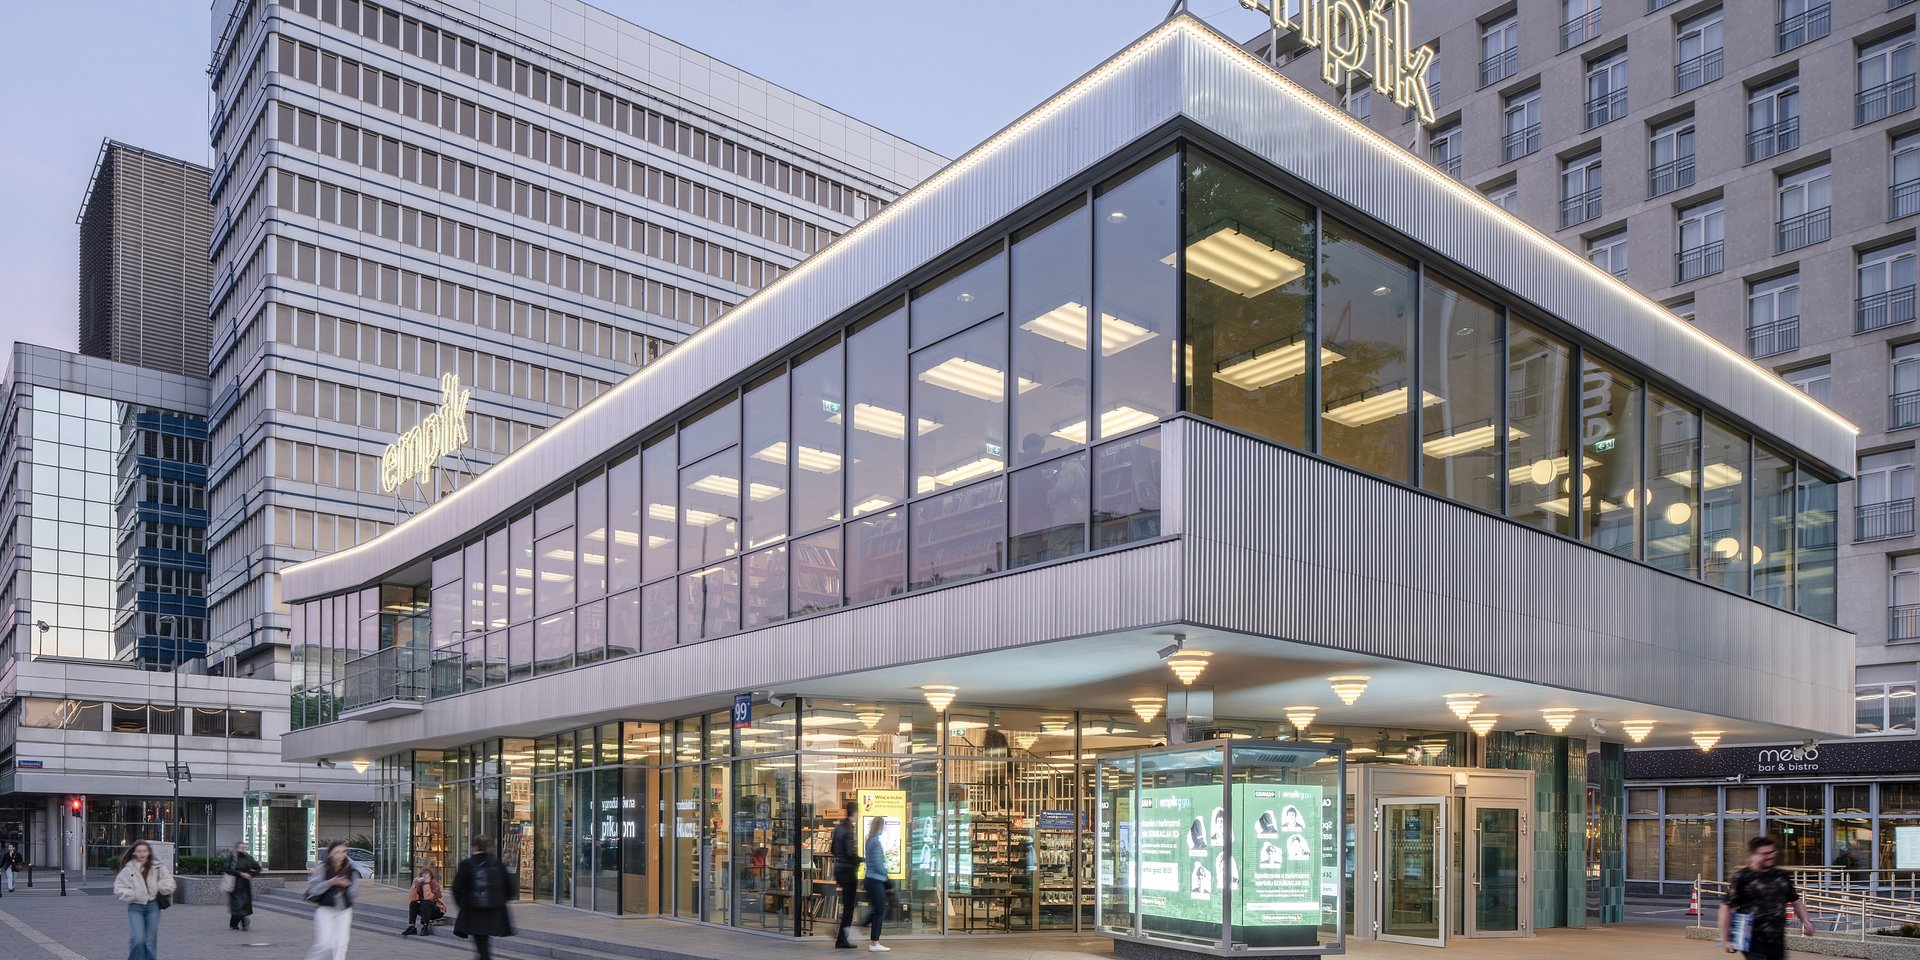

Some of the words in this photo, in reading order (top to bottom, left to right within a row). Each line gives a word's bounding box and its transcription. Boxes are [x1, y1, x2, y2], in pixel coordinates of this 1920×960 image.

[382, 372, 471, 492] empik
[735, 702, 747, 721] 99
[1759, 746, 1819, 762] meo
[1758, 764, 1775, 772] bar
[1778, 763, 1785, 771] &
[1788, 762, 1819, 771] bistro
